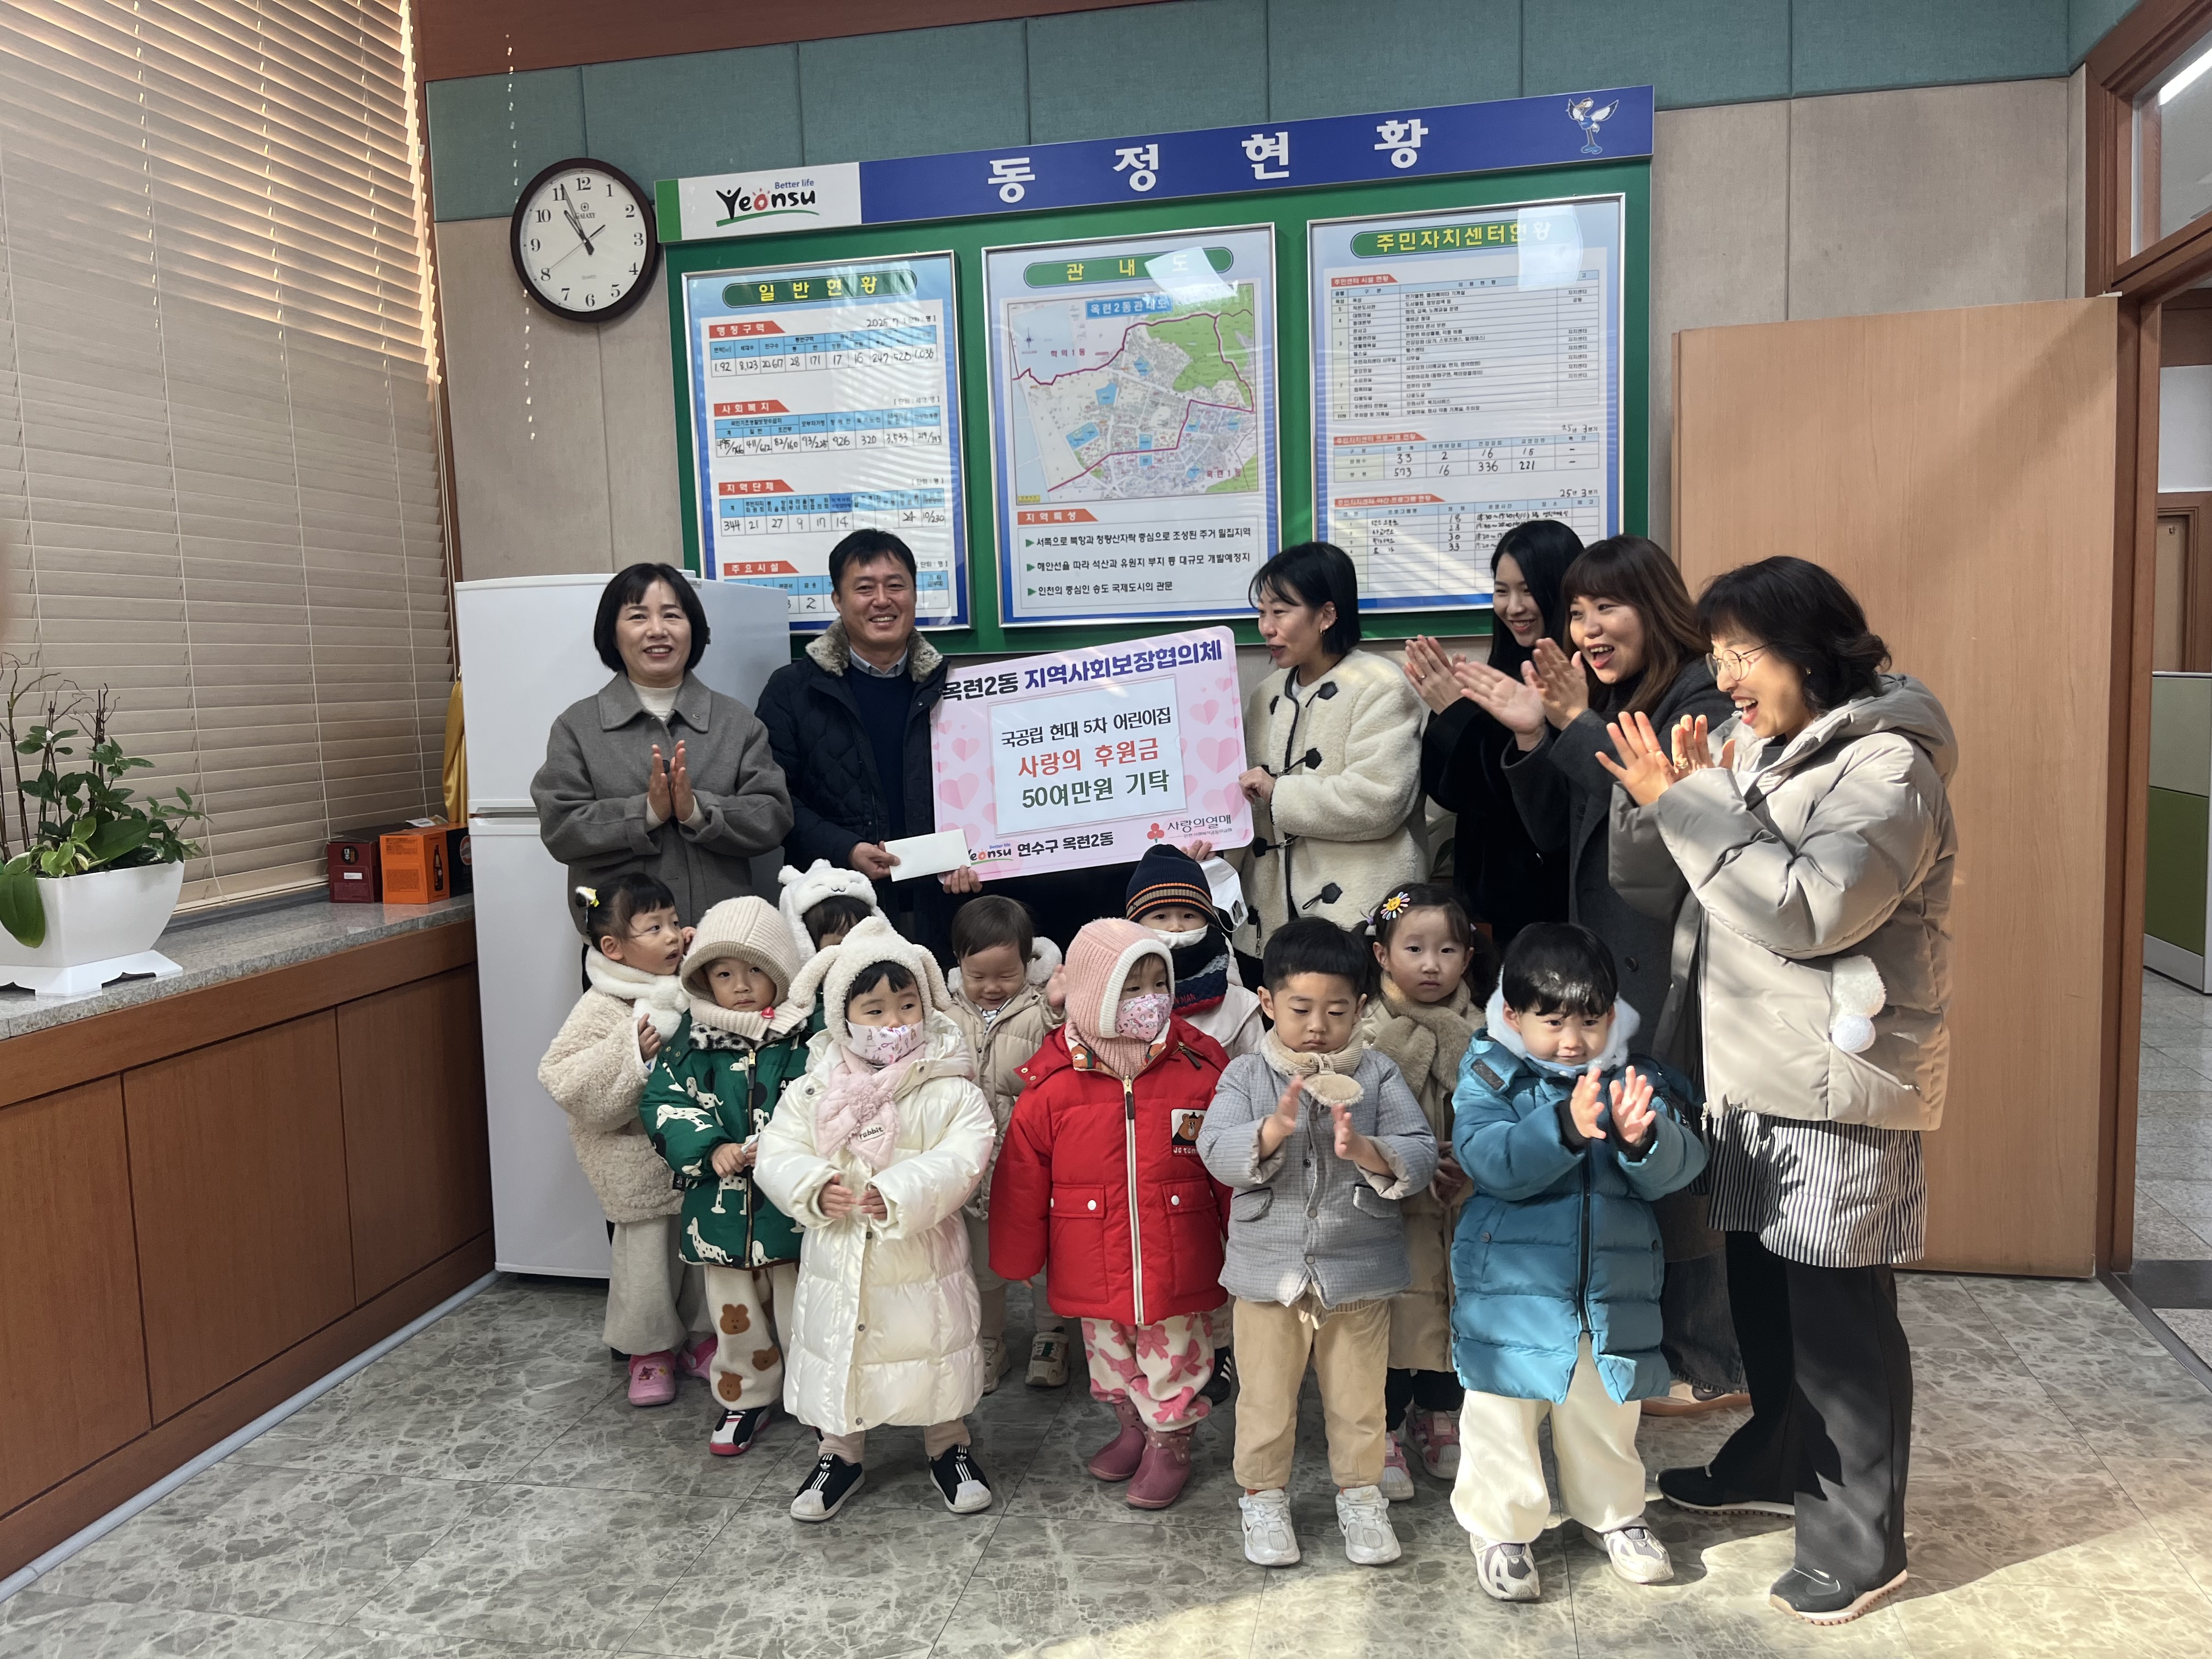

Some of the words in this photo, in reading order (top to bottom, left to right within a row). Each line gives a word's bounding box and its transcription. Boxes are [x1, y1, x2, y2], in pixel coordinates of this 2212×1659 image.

[575, 177, 591, 191] 12
[775, 180, 799, 190] Better
[801, 178, 815, 188] life
[552, 188, 567, 201] 11
[606, 184, 613, 198] 1
[716, 187, 816, 219] Yeonsu
[535, 209, 551, 223] 10
[625, 204, 635, 218] 2
[531, 239, 540, 252] 9
[634, 233, 644, 246] 3
[540, 268, 551, 281] 8
[629, 262, 639, 275] 4
[561, 287, 570, 301] 7
[611, 284, 620, 297] 5
[585, 294, 595, 307] 6
[790, 357, 800, 366] 28
[810, 356, 821, 365] 171
[833, 354, 842, 365] 17
[855, 353, 864, 364] 16
[833, 436, 850, 446] 926
[861, 435, 877, 445] 320
[1397, 454, 1412, 464] 33
[1442, 451, 1448, 460] 2
[1482, 448, 1493, 459] 16
[1439, 464, 1449, 476] 16
[1478, 460, 1498, 472] 336
[1519, 460, 1535, 470] 221
[1394, 467, 1412, 477] 573
[724, 520, 741, 532] 344
[749, 520, 759, 529] 21
[772, 518, 783, 529] 27
[797, 518, 803, 529] 9
[1036, 536, 1068, 548] 서쪽으로
[1096, 533, 1136, 545] 청량산자락
[1138, 532, 1171, 543] 중심으로
[1173, 530, 1197, 541] 조성된
[1199, 529, 1216, 539] 주거
[1218, 527, 1251, 538] 밀집지역
[1037, 560, 1070, 572] 해안선을
[1073, 560, 1090, 570] 따라
[1092, 559, 1118, 569] 석산과
[1121, 557, 1146, 568] 유원지
[1148, 556, 1165, 567] 부지
[1168, 556, 1176, 566] 등
[1179, 555, 1204, 566] 대규모
[1207, 552, 1250, 564] 개발예정지
[1038, 585, 1063, 596] 인천의
[1065, 584, 1090, 596] 중심인
[1093, 584, 1109, 594] 송도
[1111, 582, 1153, 593] 국제도시의
[1156, 581, 1173, 591] 관문
[806, 597, 816, 609] 2
[941, 672, 1018, 702] 옥련2동
[1025, 639, 1222, 690] 지역사회보장협의체
[1001, 727, 1044, 747] 국공립
[1050, 720, 1079, 741] 현대
[1084, 715, 1107, 734] 5차
[1113, 707, 1171, 730] 어린이집
[1018, 748, 1082, 778] 사랑의
[1094, 737, 1159, 764] 후원금
[1022, 775, 1113, 809] 50여만원
[1126, 769, 1170, 795] 기탁
[1167, 814, 1231, 833] 사랑의열매
[1017, 839, 1059, 857] 연수구
[1063, 831, 1114, 850] 옥련2동
[859, 1127, 884, 1139] rabbit
